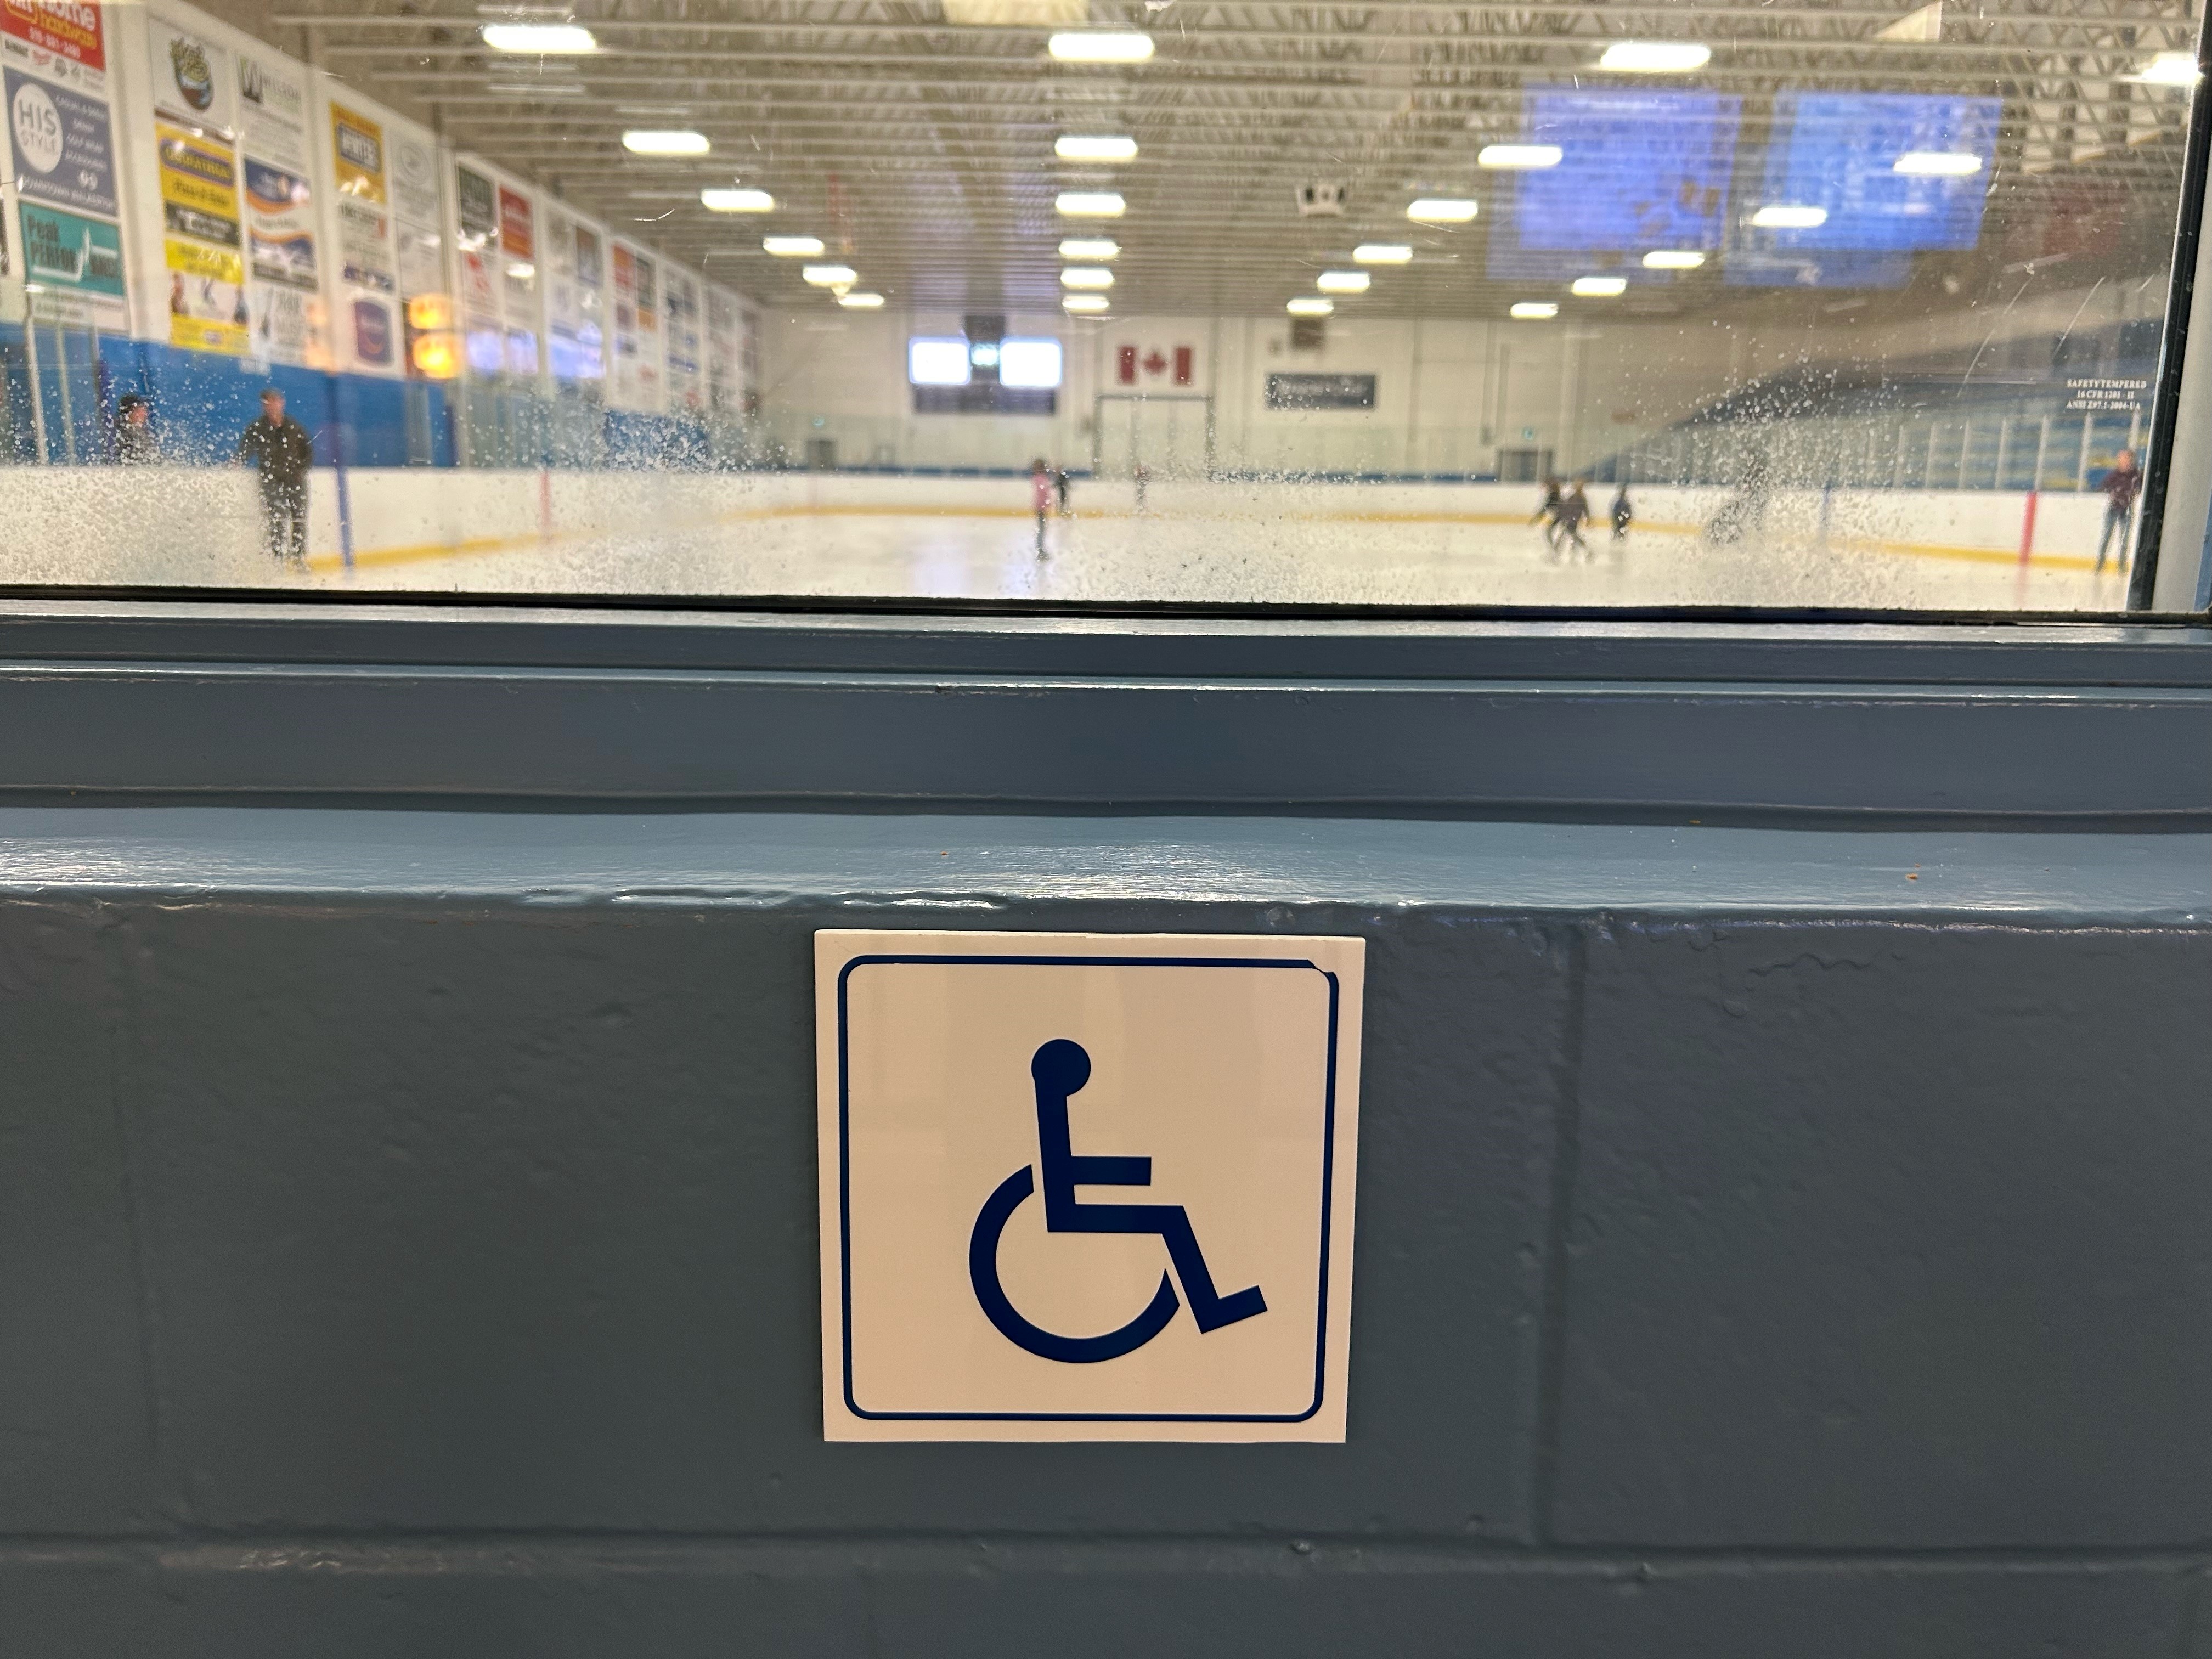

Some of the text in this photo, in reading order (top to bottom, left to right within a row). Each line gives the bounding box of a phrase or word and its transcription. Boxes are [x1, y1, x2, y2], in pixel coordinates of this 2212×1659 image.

[18, 99, 57, 137] HIS
[20, 130, 59, 155] STYLE
[27, 213, 60, 242] Peak
[2066, 379, 2147, 390] SAFETY TEMPERED
[2086, 390, 2103, 399] CFR
